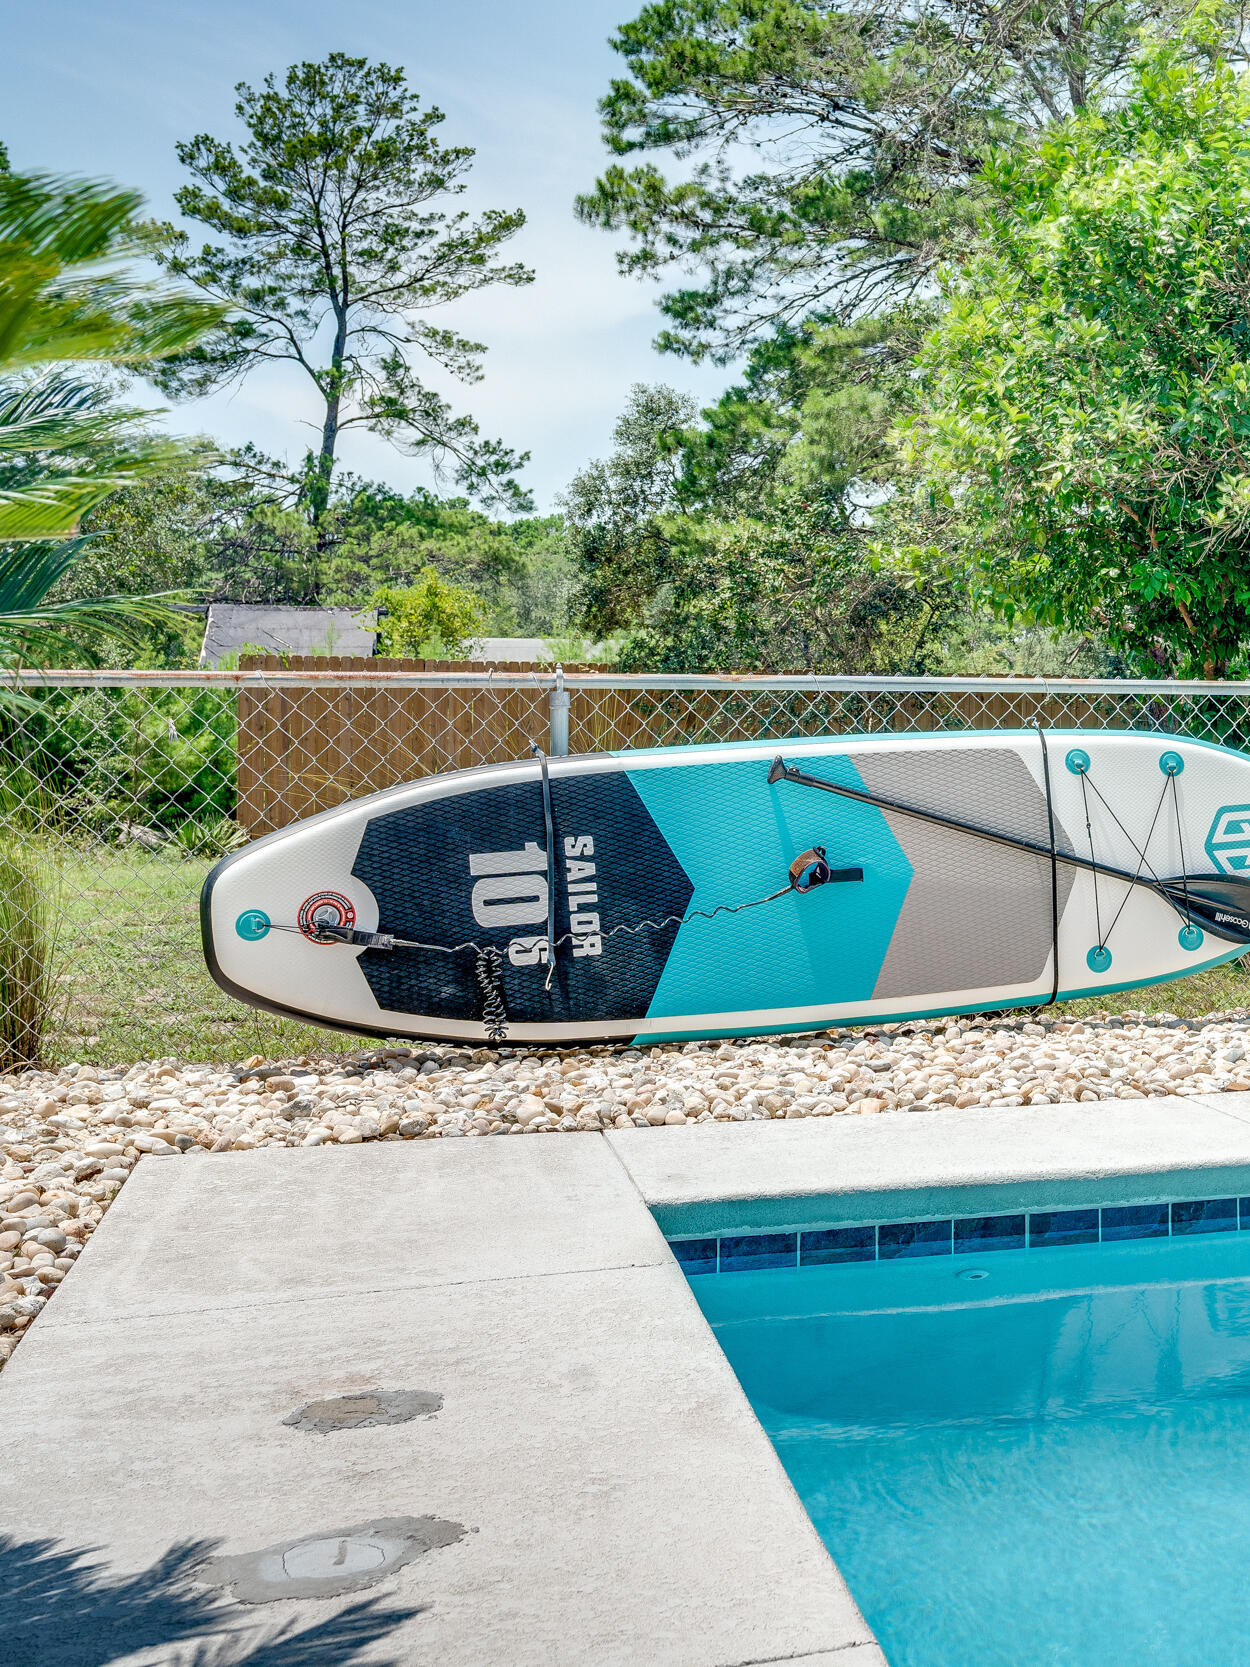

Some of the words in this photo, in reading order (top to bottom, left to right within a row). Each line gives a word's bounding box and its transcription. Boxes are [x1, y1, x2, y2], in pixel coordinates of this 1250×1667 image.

[469, 842, 549, 928] 10
[509, 936, 549, 966] 6
[564, 836, 602, 957] SAILOR
[1215, 912, 1249, 928] Goosehill
